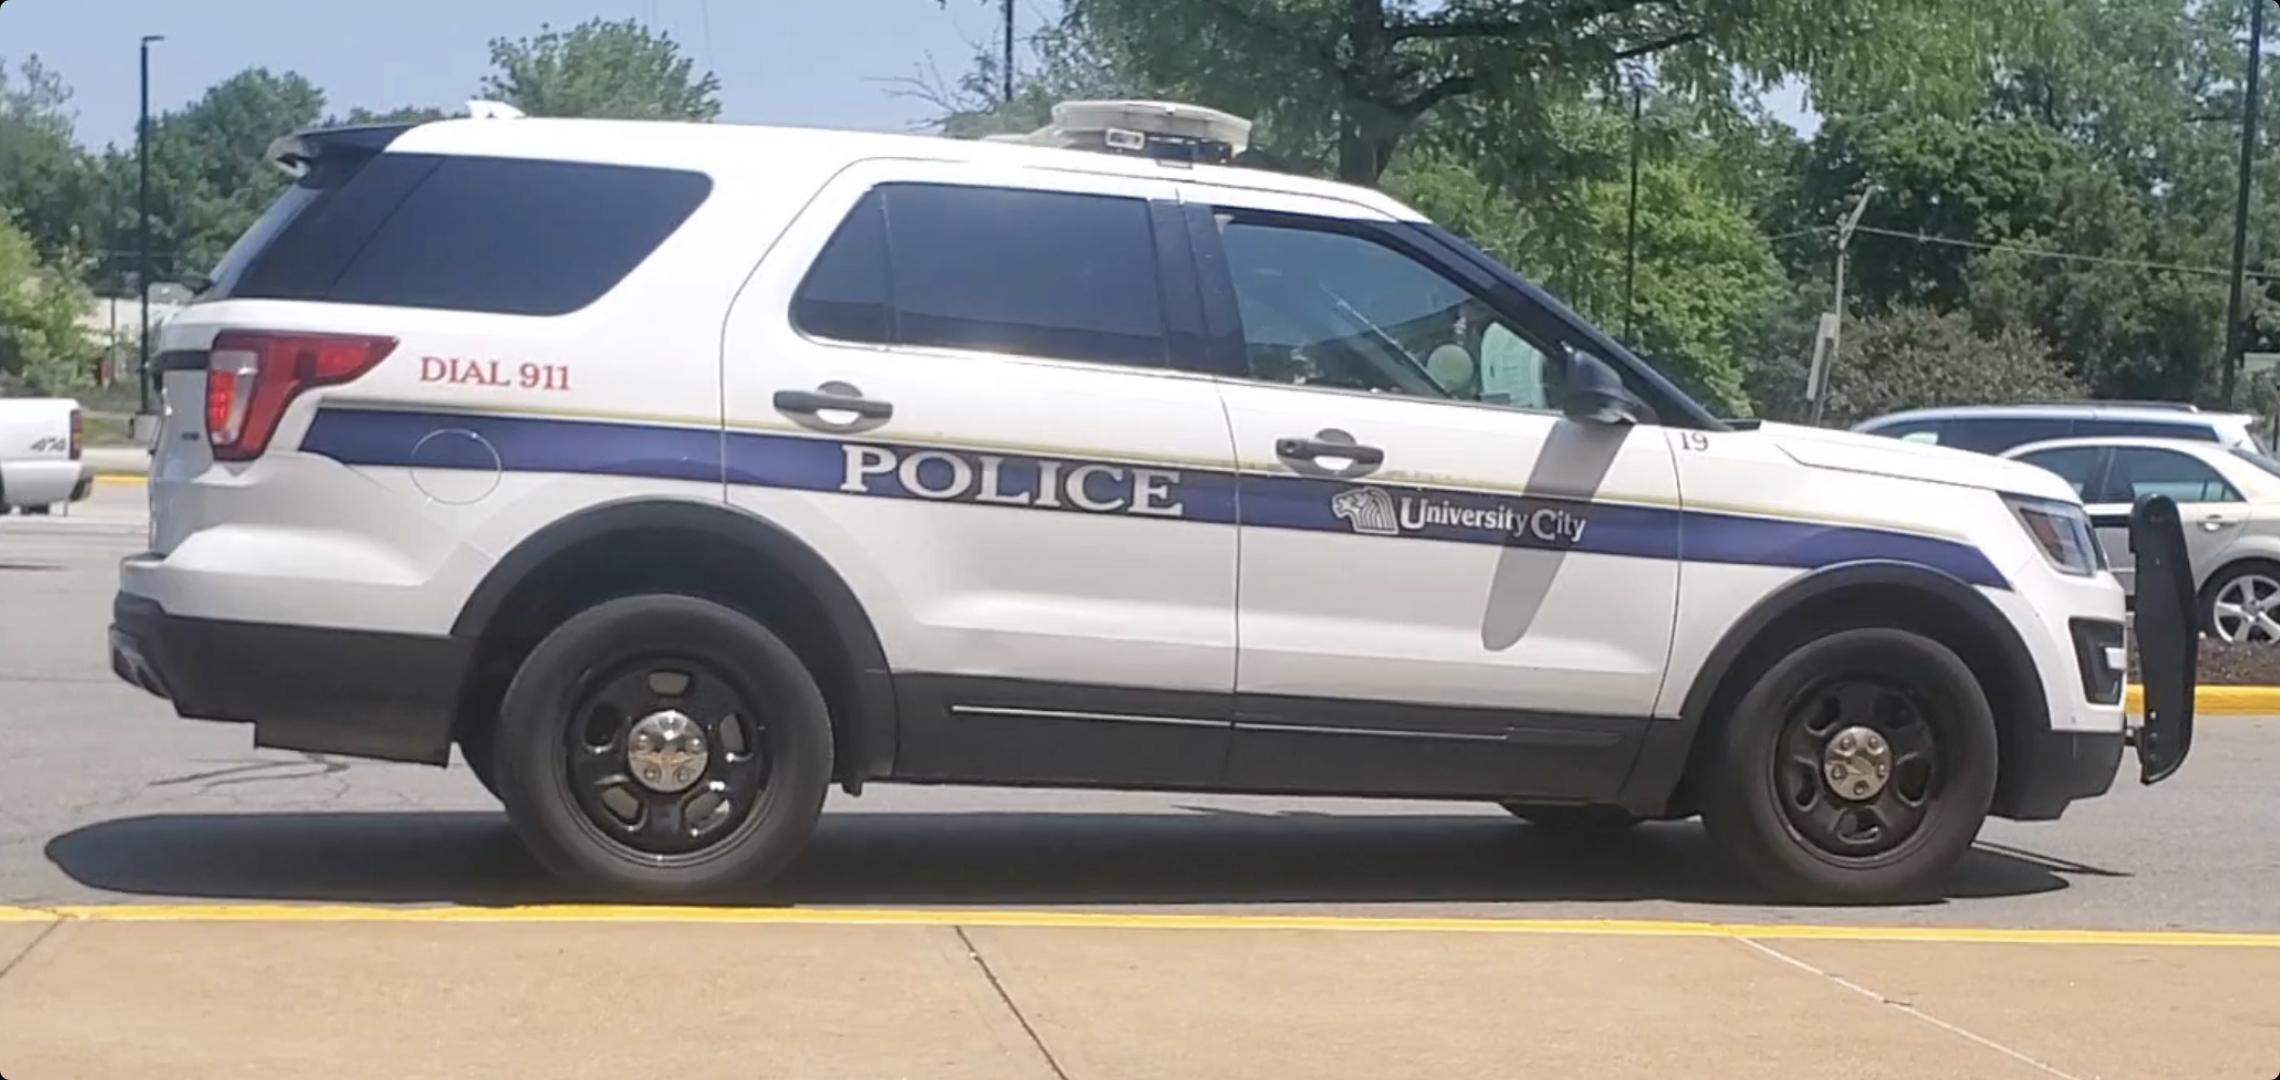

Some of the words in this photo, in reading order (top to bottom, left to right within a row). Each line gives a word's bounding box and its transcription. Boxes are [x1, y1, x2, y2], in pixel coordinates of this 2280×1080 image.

[420, 356, 511, 387] DIAL
[518, 362, 571, 390] 911
[1680, 431, 1709, 452] 19
[839, 444, 1184, 516] POLICE
[1399, 497, 1528, 538] University
[1530, 509, 1587, 542] City
